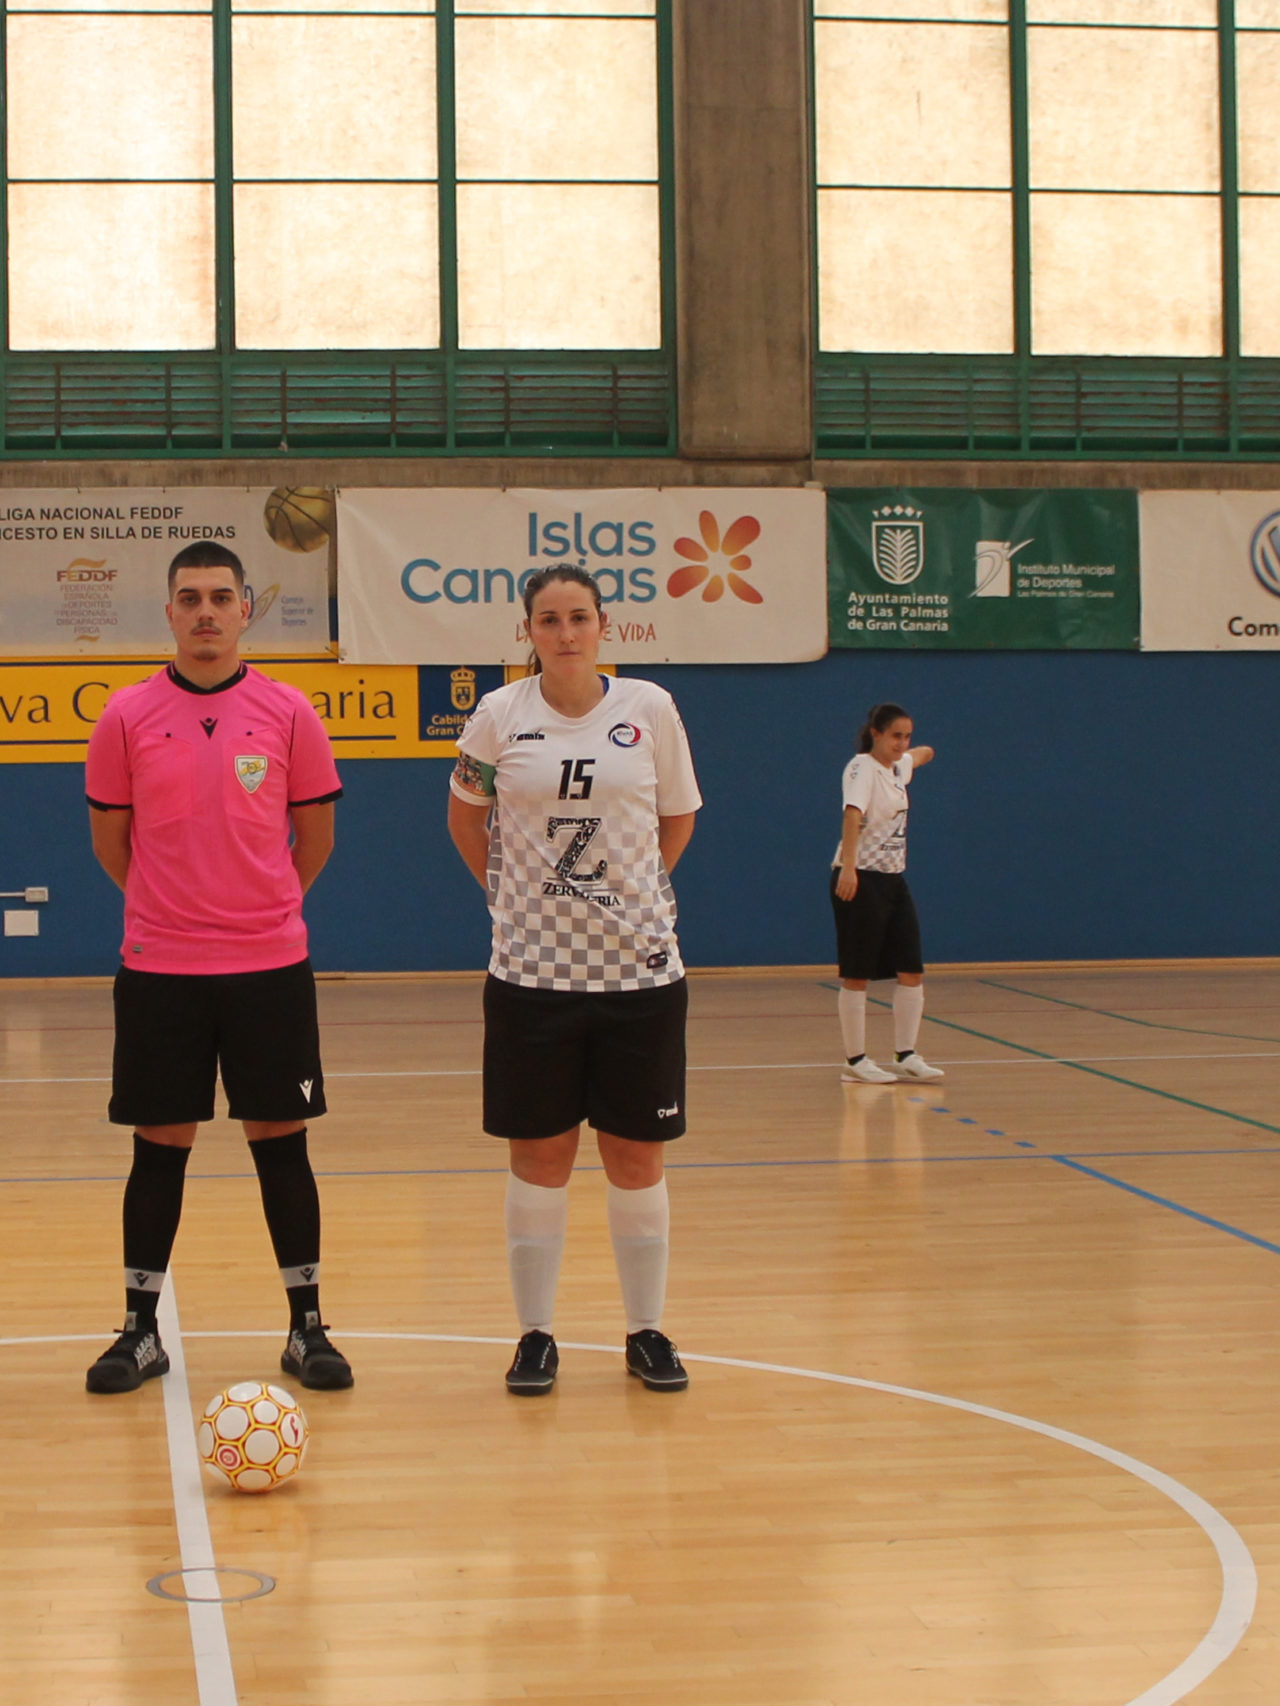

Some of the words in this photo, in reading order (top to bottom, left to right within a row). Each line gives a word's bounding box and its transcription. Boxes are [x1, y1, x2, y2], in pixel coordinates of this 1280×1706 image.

[40, 507, 125, 520] NACIONAL
[130, 506, 183, 519] FEDDF
[62, 527, 84, 540] EN
[90, 526, 136, 539] SILLA
[141, 526, 162, 539] DE
[168, 526, 236, 539] RUEDAS
[528, 512, 657, 557] Islas
[56, 569, 118, 581] FEDDF
[1017, 564, 1060, 575] Instituto
[1062, 564, 1116, 577] Municipal
[400, 558, 657, 604] Canas
[1032, 577, 1082, 590] Deportes
[847, 592, 949, 606] Ayuntamiento
[847, 605, 865, 617] de
[871, 606, 894, 617] Las
[900, 606, 949, 618] Palmas
[618, 621, 657, 643] VIDA
[847, 618, 864, 630] de
[866, 619, 897, 631] Gran
[900, 619, 949, 632] Canaria
[311, 679, 396, 719] aria
[431, 714, 469, 725] Cabild
[426, 725, 455, 736] Gran
[558, 758, 596, 801] 15
